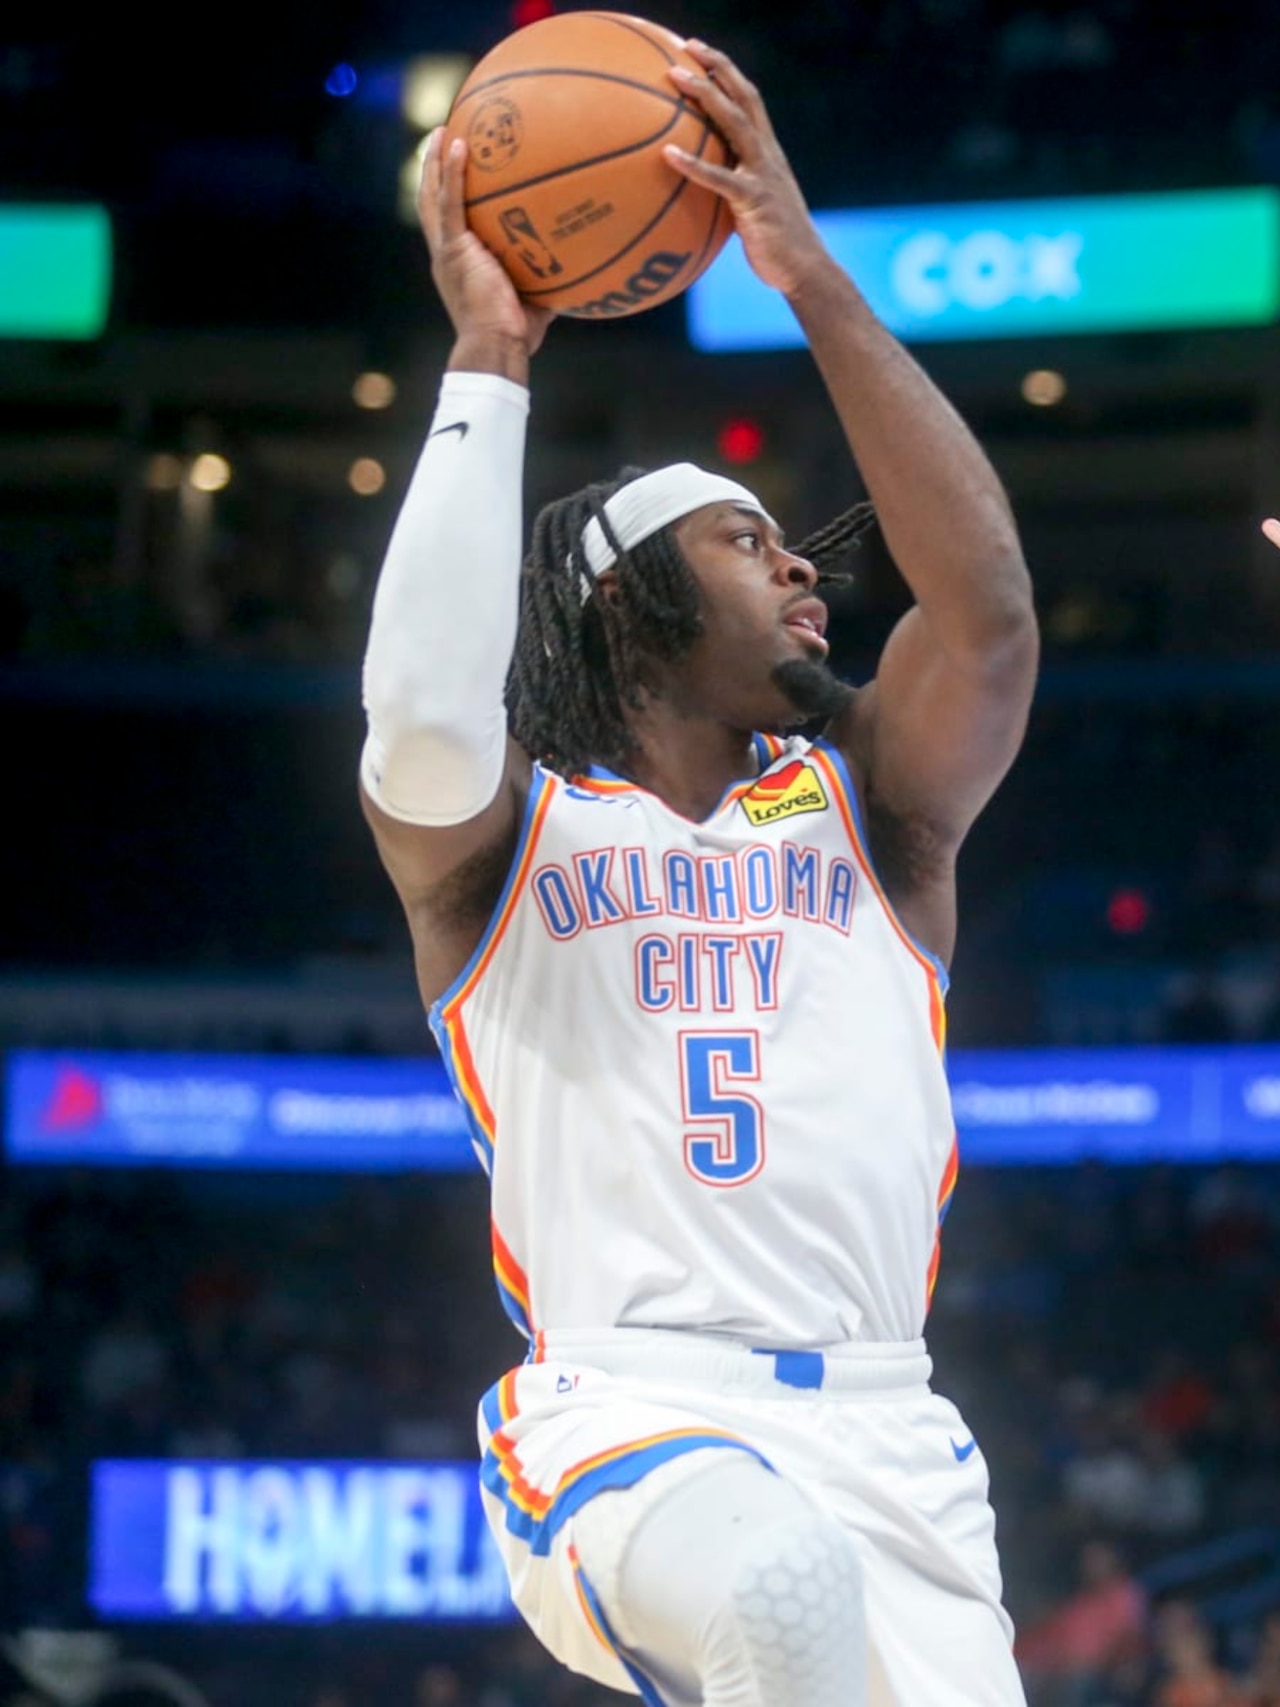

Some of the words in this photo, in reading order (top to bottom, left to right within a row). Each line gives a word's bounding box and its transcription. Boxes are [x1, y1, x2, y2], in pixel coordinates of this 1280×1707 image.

[892, 230, 1083, 317] COX
[531, 840, 858, 942] OKLAHOMA
[634, 931, 784, 1013] CITY
[677, 1029, 766, 1188] 5
